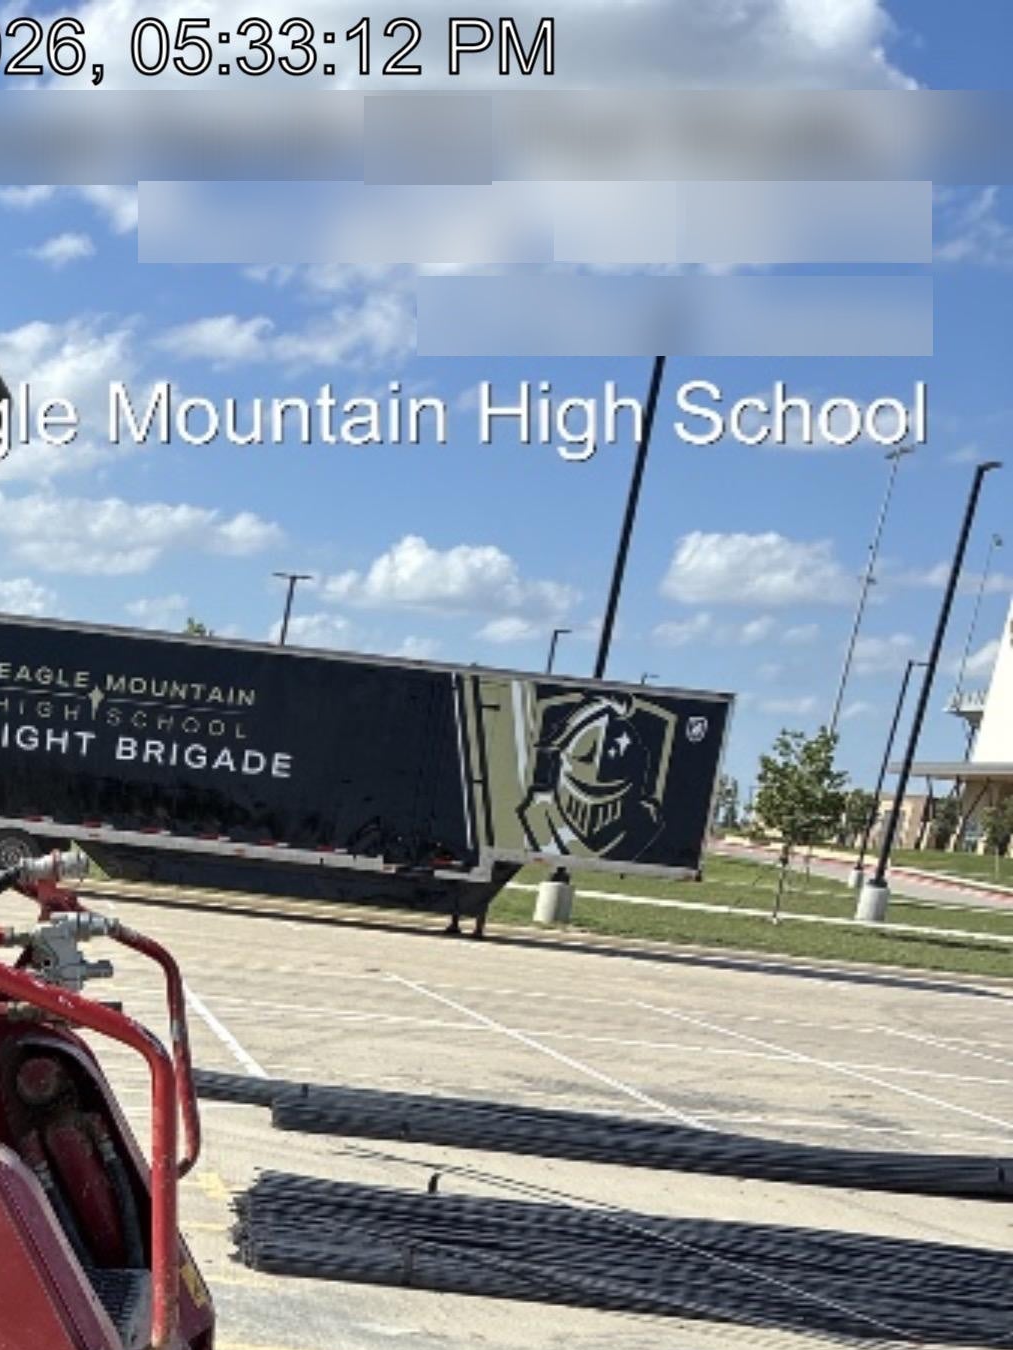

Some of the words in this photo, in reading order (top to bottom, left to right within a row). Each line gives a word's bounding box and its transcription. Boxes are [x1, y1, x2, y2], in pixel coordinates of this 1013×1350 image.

[105, 674, 256, 706] MOUNTAIN
[106, 707, 248, 739] SCHOOL
[115, 736, 293, 778] BRIGADE
